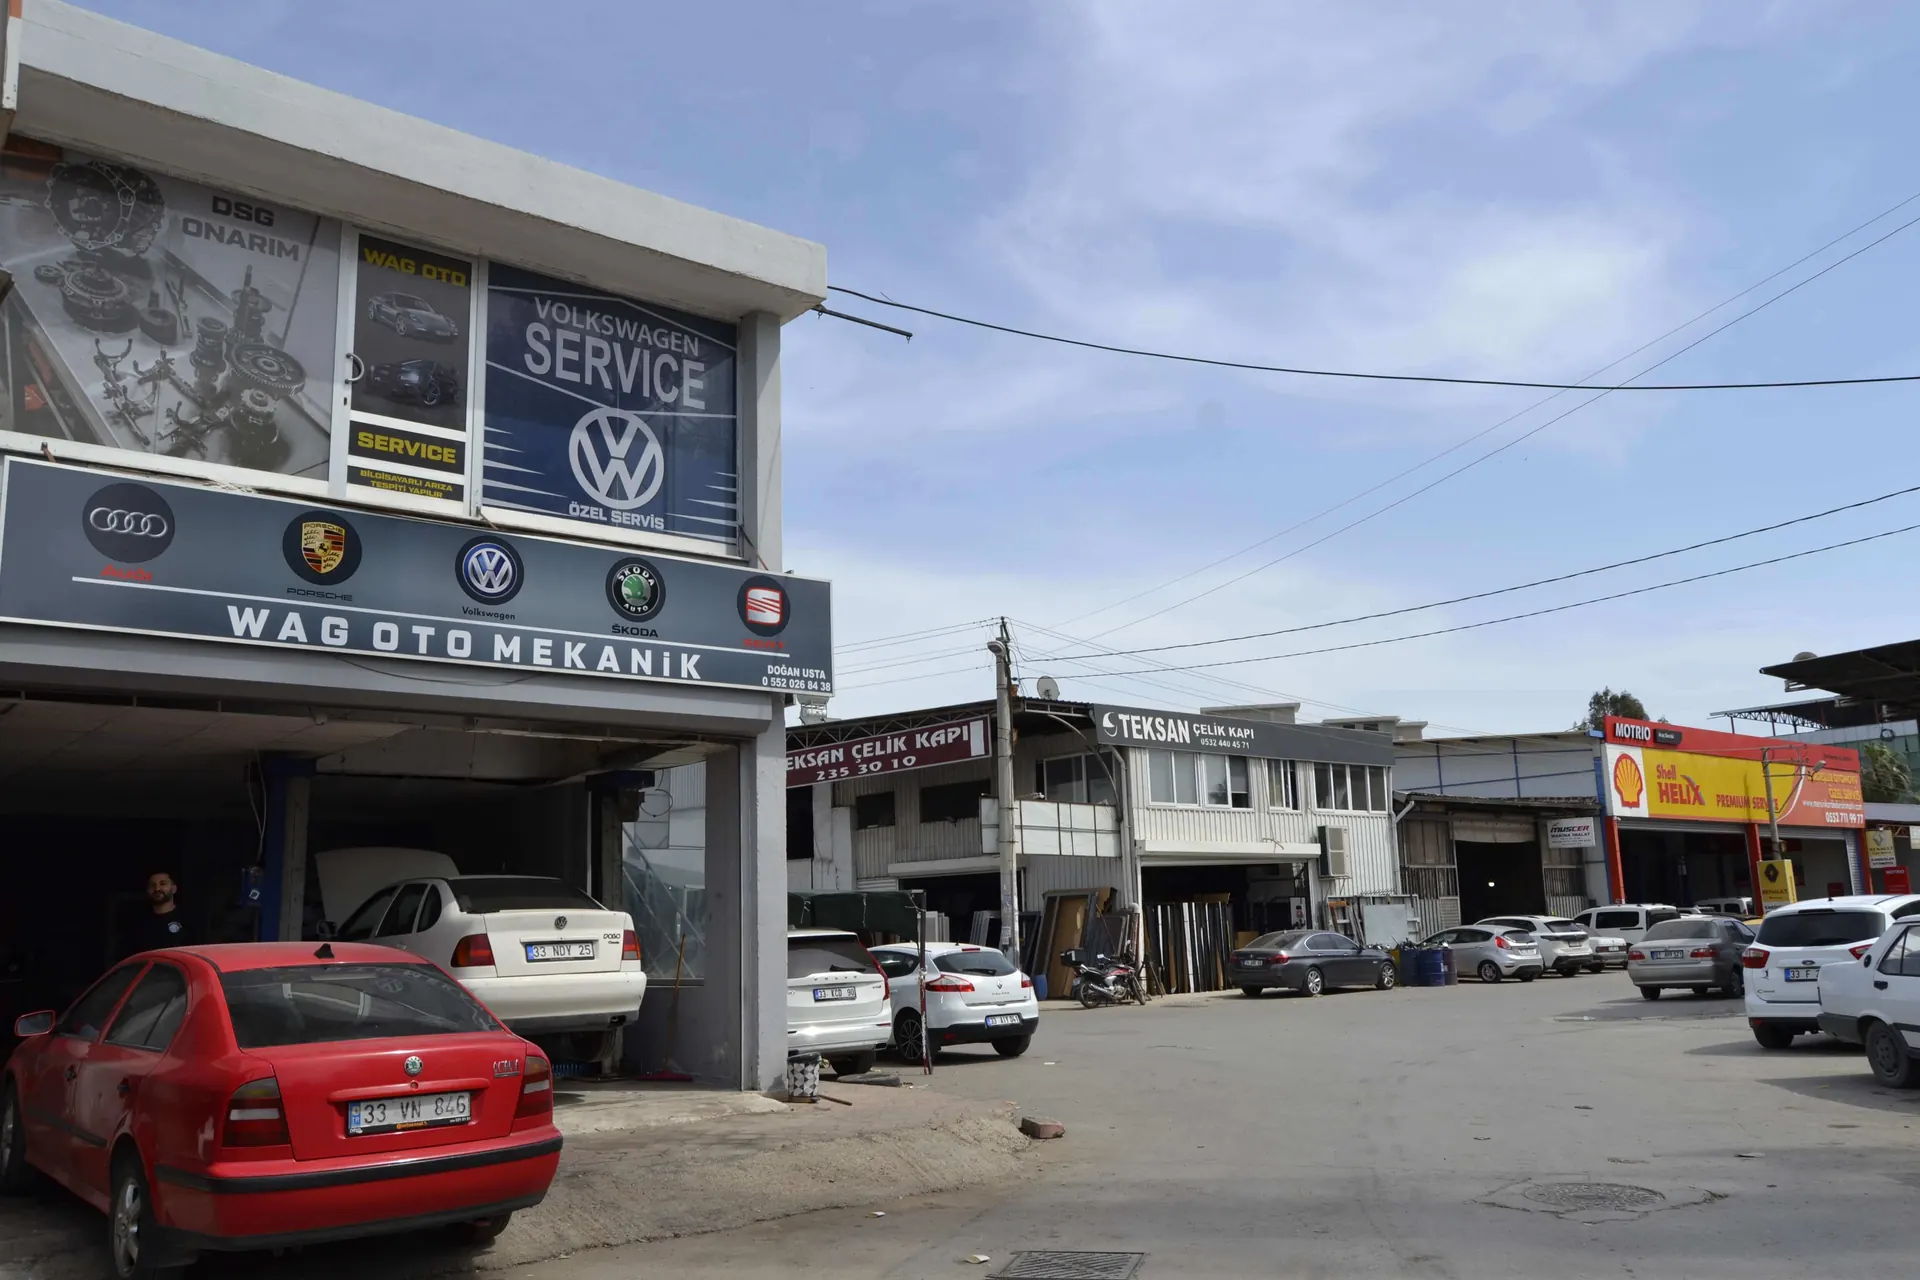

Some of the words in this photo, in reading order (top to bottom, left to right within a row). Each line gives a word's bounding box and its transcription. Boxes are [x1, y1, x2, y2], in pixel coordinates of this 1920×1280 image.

[213, 195, 275, 226] DSG
[182, 216, 299, 261] ONARIM
[364, 248, 416, 274] WAG
[422, 264, 466, 286] OTO
[534, 297, 699, 357] VOLKSWAGEN
[524, 322, 706, 410] SERVICE
[358, 432, 456, 464] SERVICE
[408, 486, 443, 498] YAPILIR
[425, 480, 453, 492] ARIZA
[568, 500, 608, 523] ÖZEL
[611, 509, 665, 530] SERVİS
[100, 564, 153, 582] Audi
[286, 587, 353, 602] PORSCHE
[462, 606, 516, 620] Volkswagen
[624, 603, 649, 612] AUTO
[228, 605, 349, 646] WAG
[372, 622, 472, 659] OTO
[611, 624, 659, 638] ŠKODA
[767, 664, 800, 678] DOĞAN
[802, 668, 826, 680] USTA
[762, 676, 768, 686] 0
[770, 678, 787, 688] 552
[789, 679, 806, 690] 026
[807, 681, 818, 691] 84
[820, 682, 831, 692] 38
[1118, 713, 1190, 744] TEKSAN
[1192, 722, 1226, 738] ÇELİK
[1228, 727, 1254, 740] KAPI
[1615, 722, 1650, 740] MOTRIO
[851, 735, 906, 764] ÇELİK
[916, 724, 969, 749] KAPI
[1200, 738, 1218, 747] 0532
[1218, 739, 1231, 748] 440
[1232, 740, 1241, 748] 45
[1242, 741, 1250, 750] 71
[816, 767, 850, 781] 235
[858, 760, 882, 775] 30
[891, 755, 916, 769] 10
[1656, 764, 1676, 780] Shell
[1656, 780, 1706, 806] HELIX
[1716, 794, 1750, 808] PREMIUM
[1753, 796, 1778, 811] SERVE
[1826, 812, 1840, 823] 0552
[1857, 814, 1864, 824] 77
[1550, 825, 1590, 833] MUSCER
[533, 946, 546, 958] 33
[552, 944, 572, 956] NDY
[578, 944, 592, 956] 25
[1790, 970, 1800, 979] 33
[1806, 970, 1811, 978] F
[818, 990, 826, 998] 33
[364, 1103, 387, 1124] 33
[400, 1102, 422, 1119] VN
[434, 1096, 466, 1116] 846
[352, 1116, 360, 1124] TR
